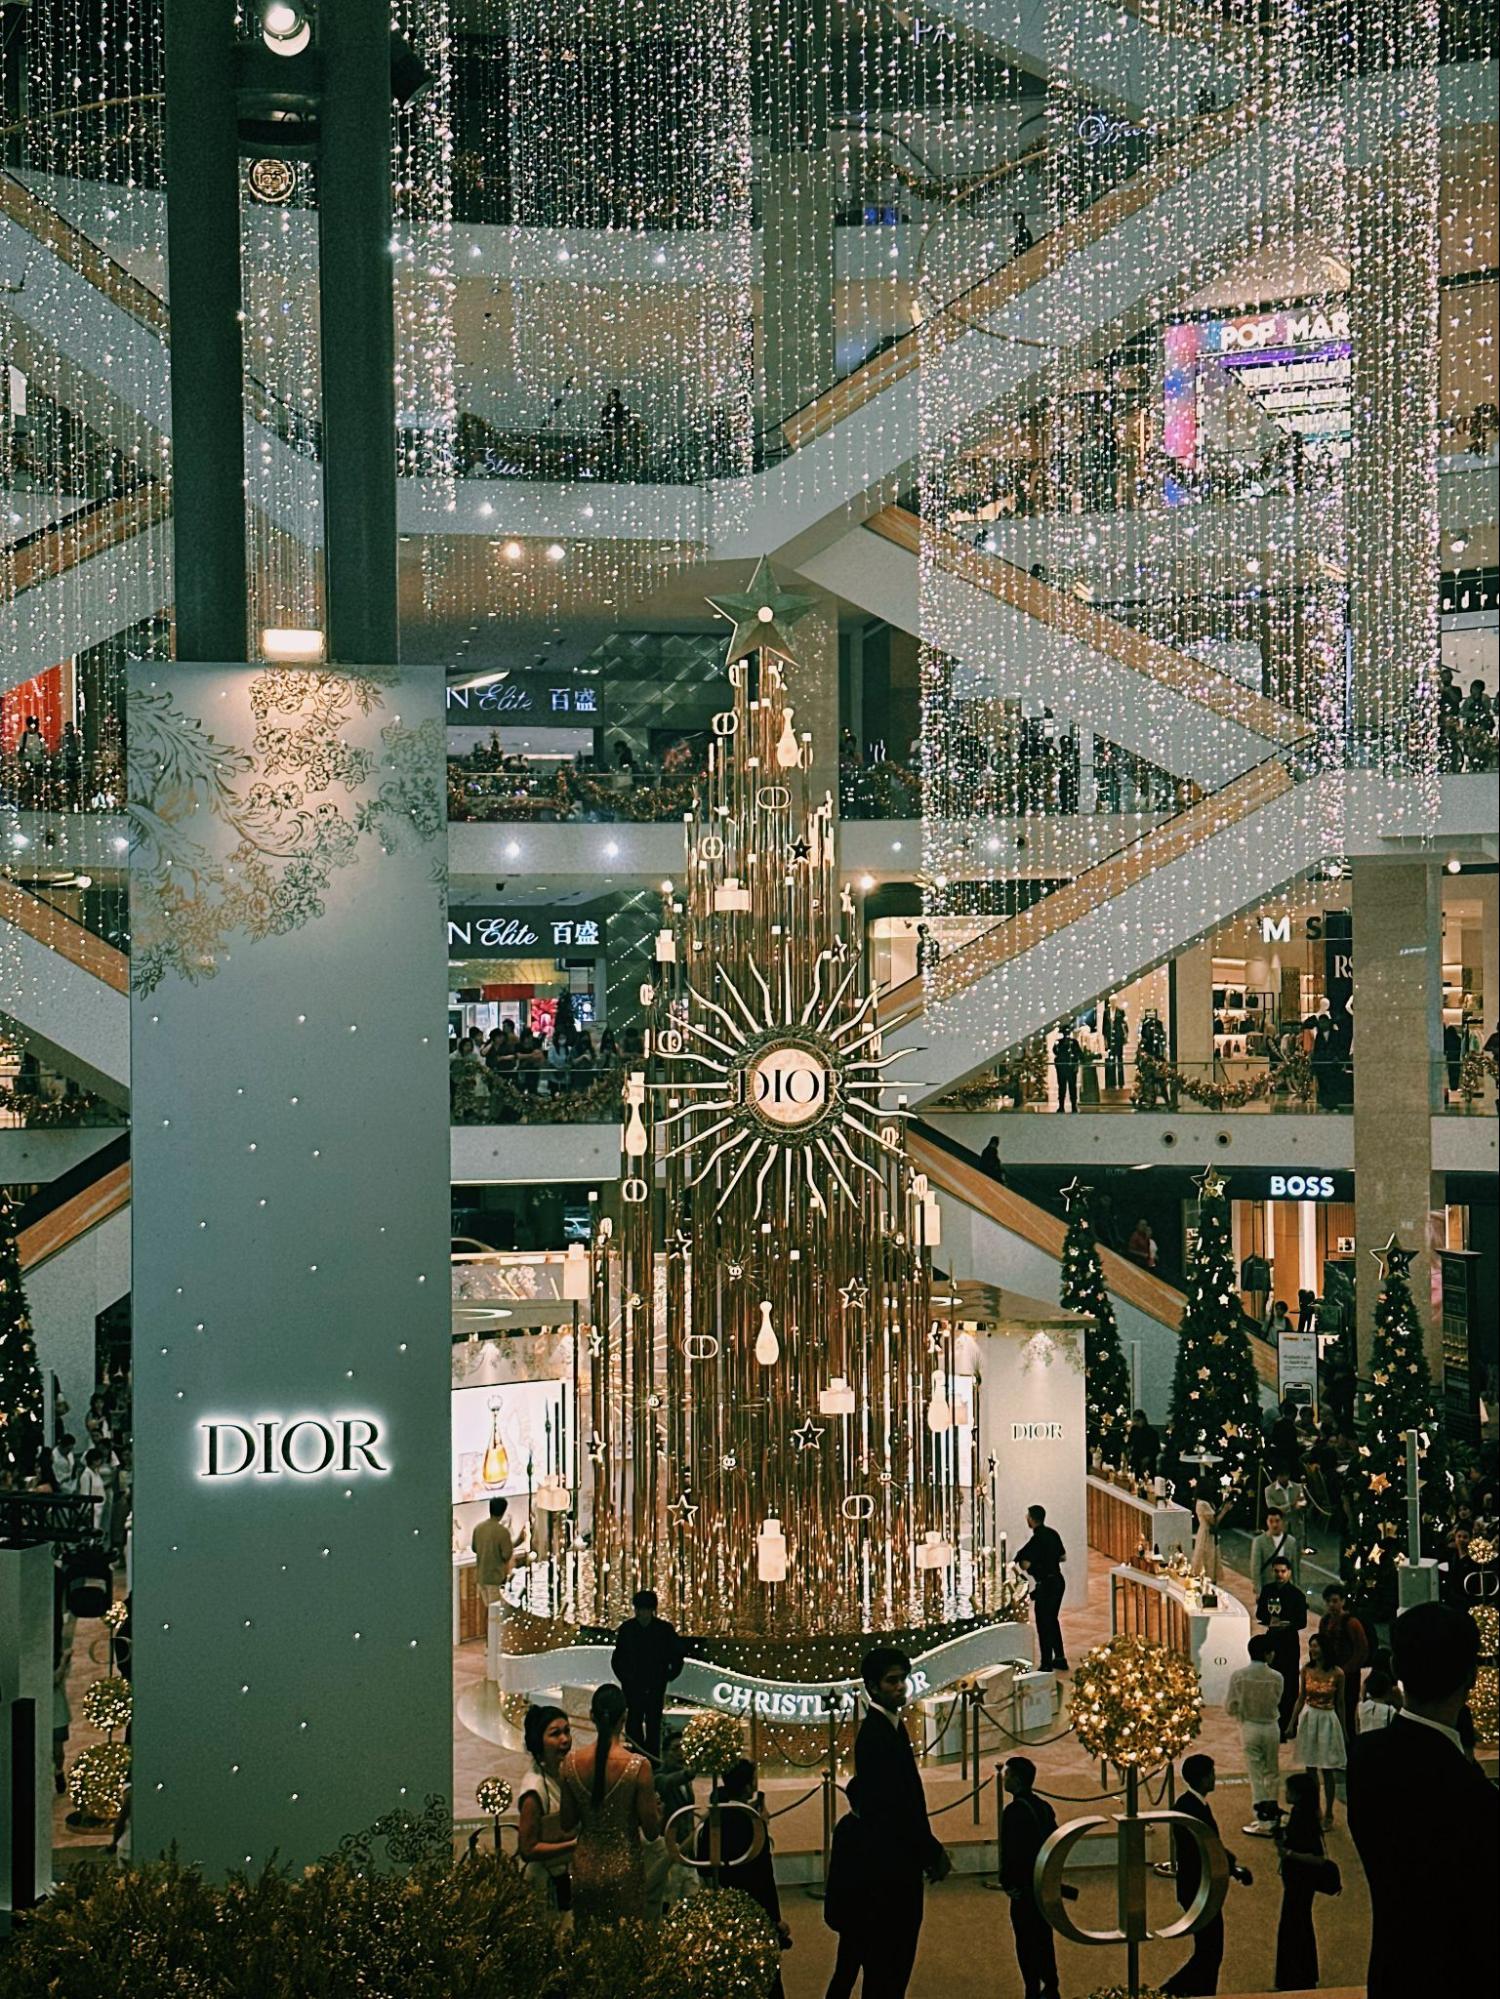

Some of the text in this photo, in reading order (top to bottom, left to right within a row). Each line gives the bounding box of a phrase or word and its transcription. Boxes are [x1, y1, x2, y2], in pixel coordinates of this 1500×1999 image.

[1220, 318, 1277, 353] POP
[474, 684, 533, 711] Elite
[549, 687, 598, 712] 百盛
[476, 918, 539, 946] Elite
[550, 919, 600, 946] 百盛
[737, 1069, 847, 1105] DIOR
[1270, 1175, 1335, 1197] BOSS
[1010, 1422, 1064, 1441] DIOR
[200, 1419, 388, 1476] DIOR
[713, 1682, 861, 1716] CHRISTIN
